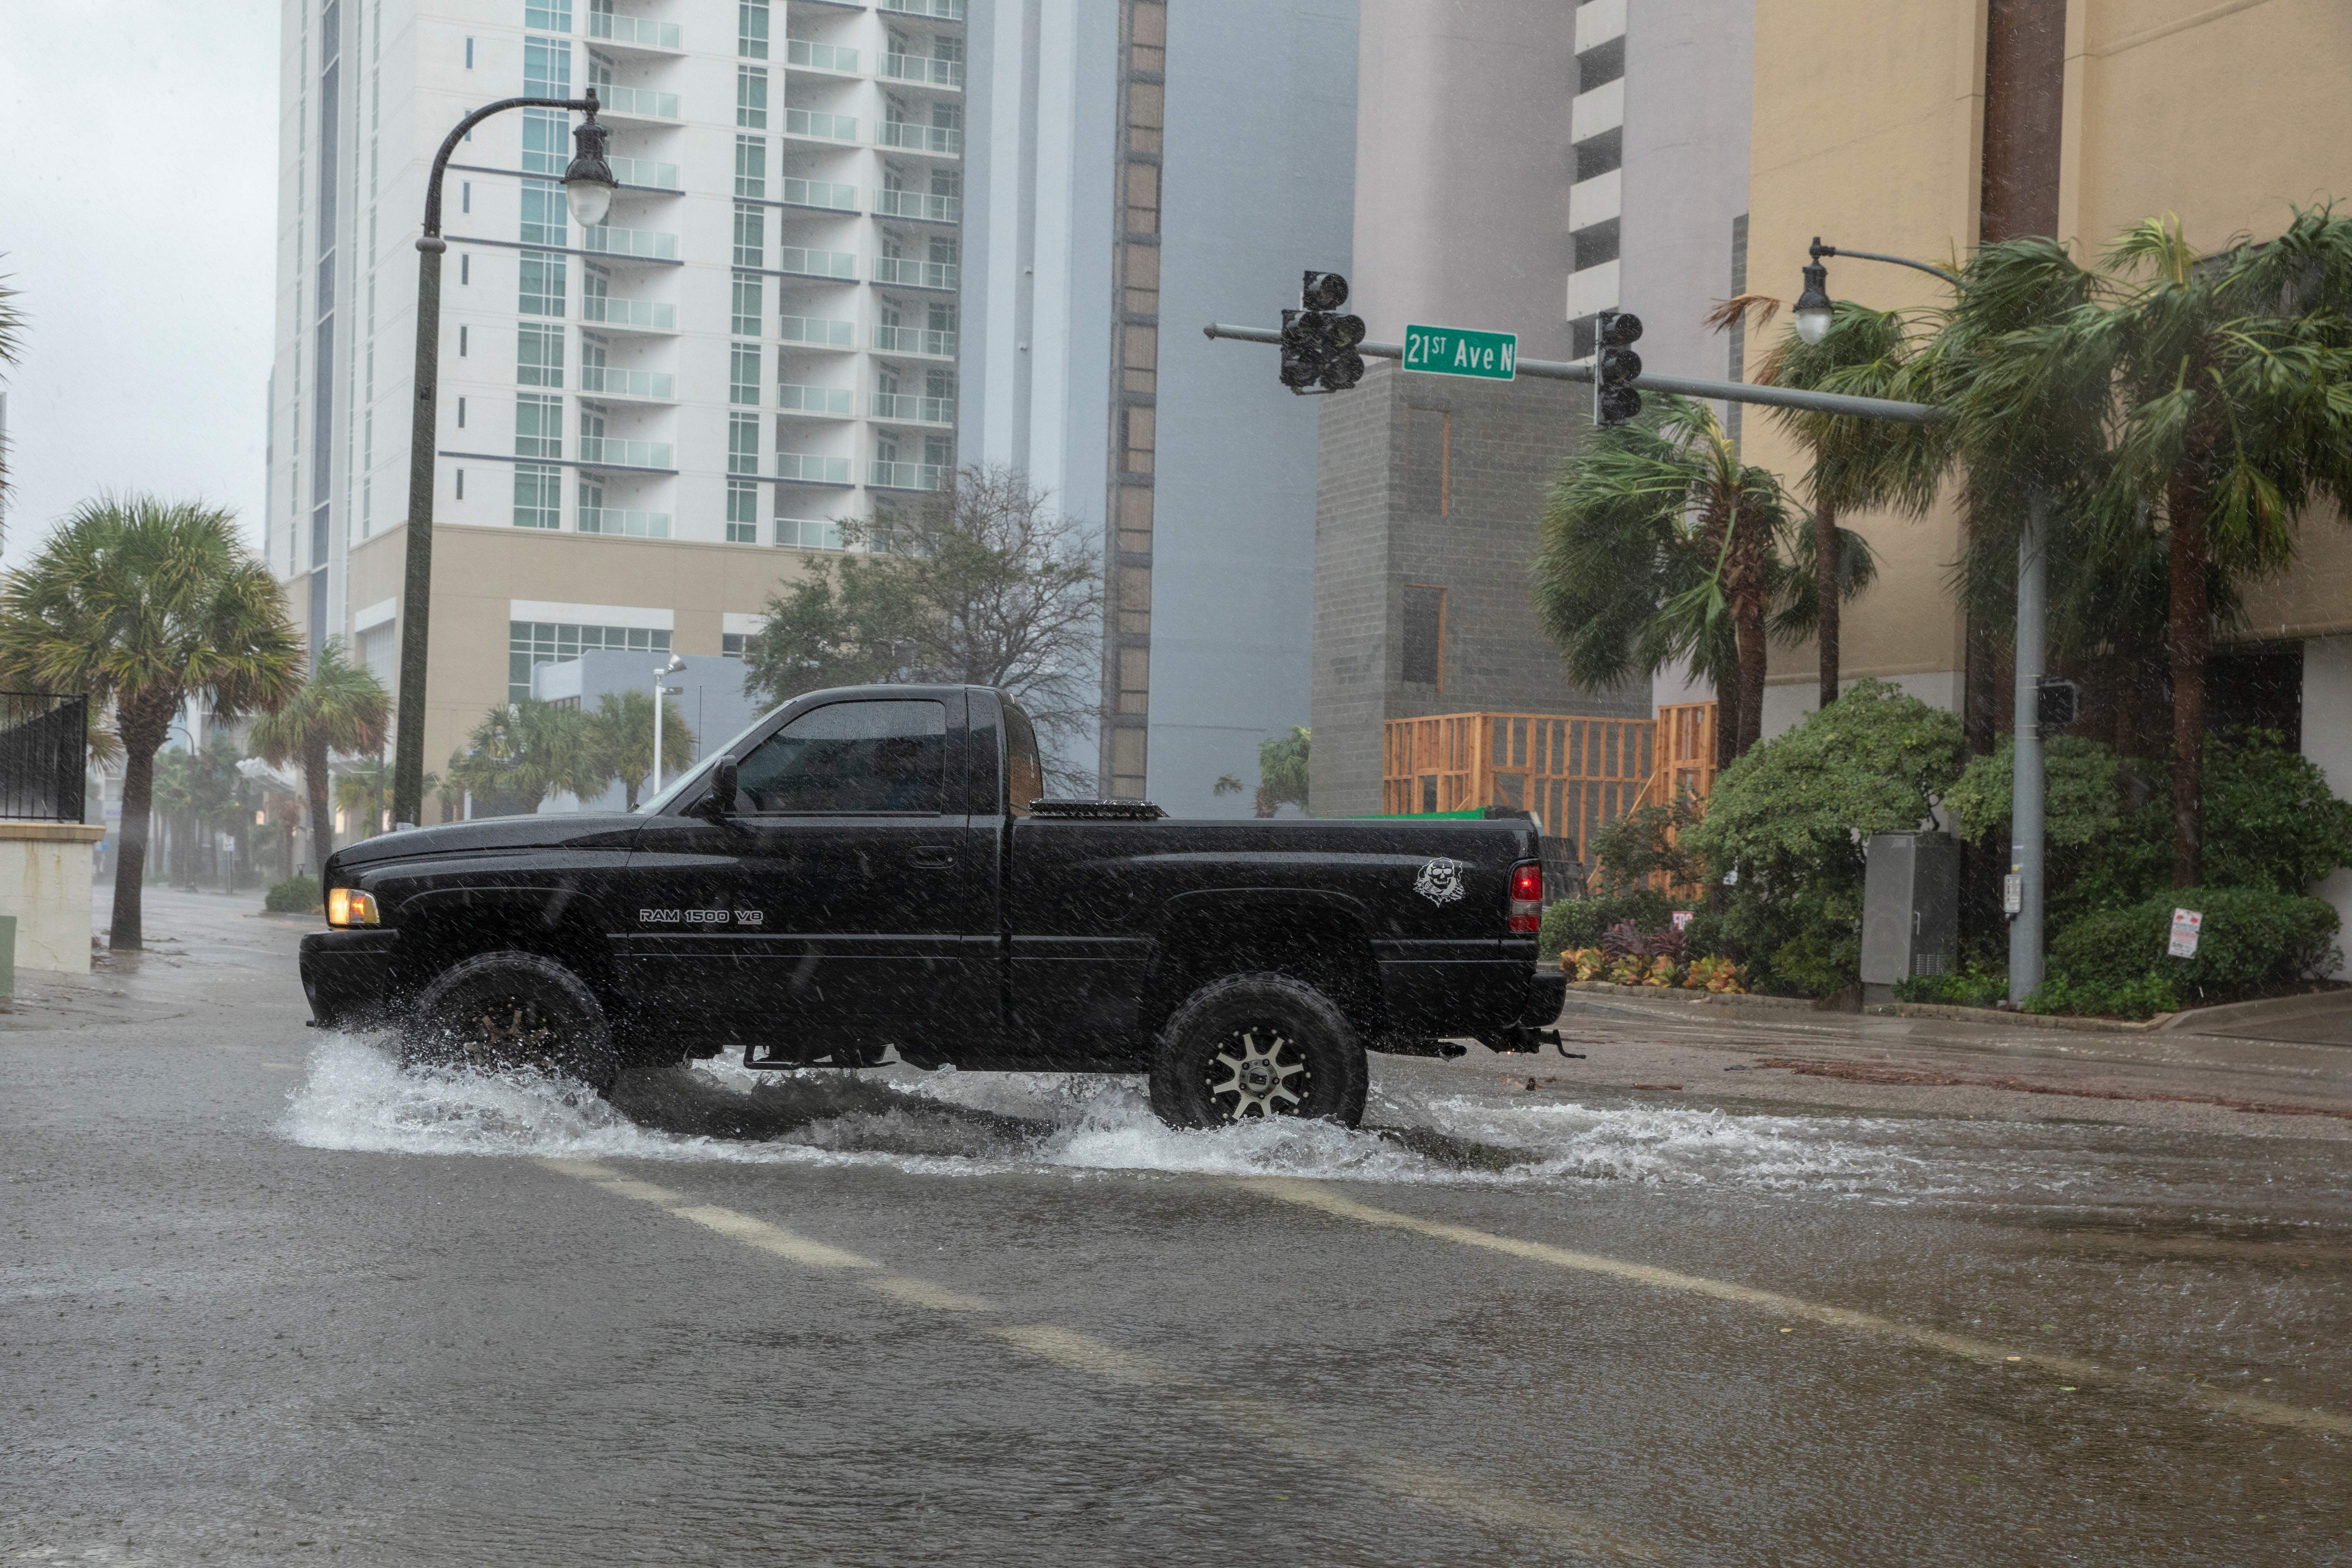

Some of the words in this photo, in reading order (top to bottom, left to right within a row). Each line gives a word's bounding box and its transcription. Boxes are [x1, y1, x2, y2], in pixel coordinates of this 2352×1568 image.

[1407, 334, 1447, 364] 21ST
[1454, 338, 1494, 370] Ave
[1500, 343, 1513, 372] N
[640, 909, 679, 922] RAM
[684, 910, 729, 923] 1500
[734, 910, 763, 921] V8
